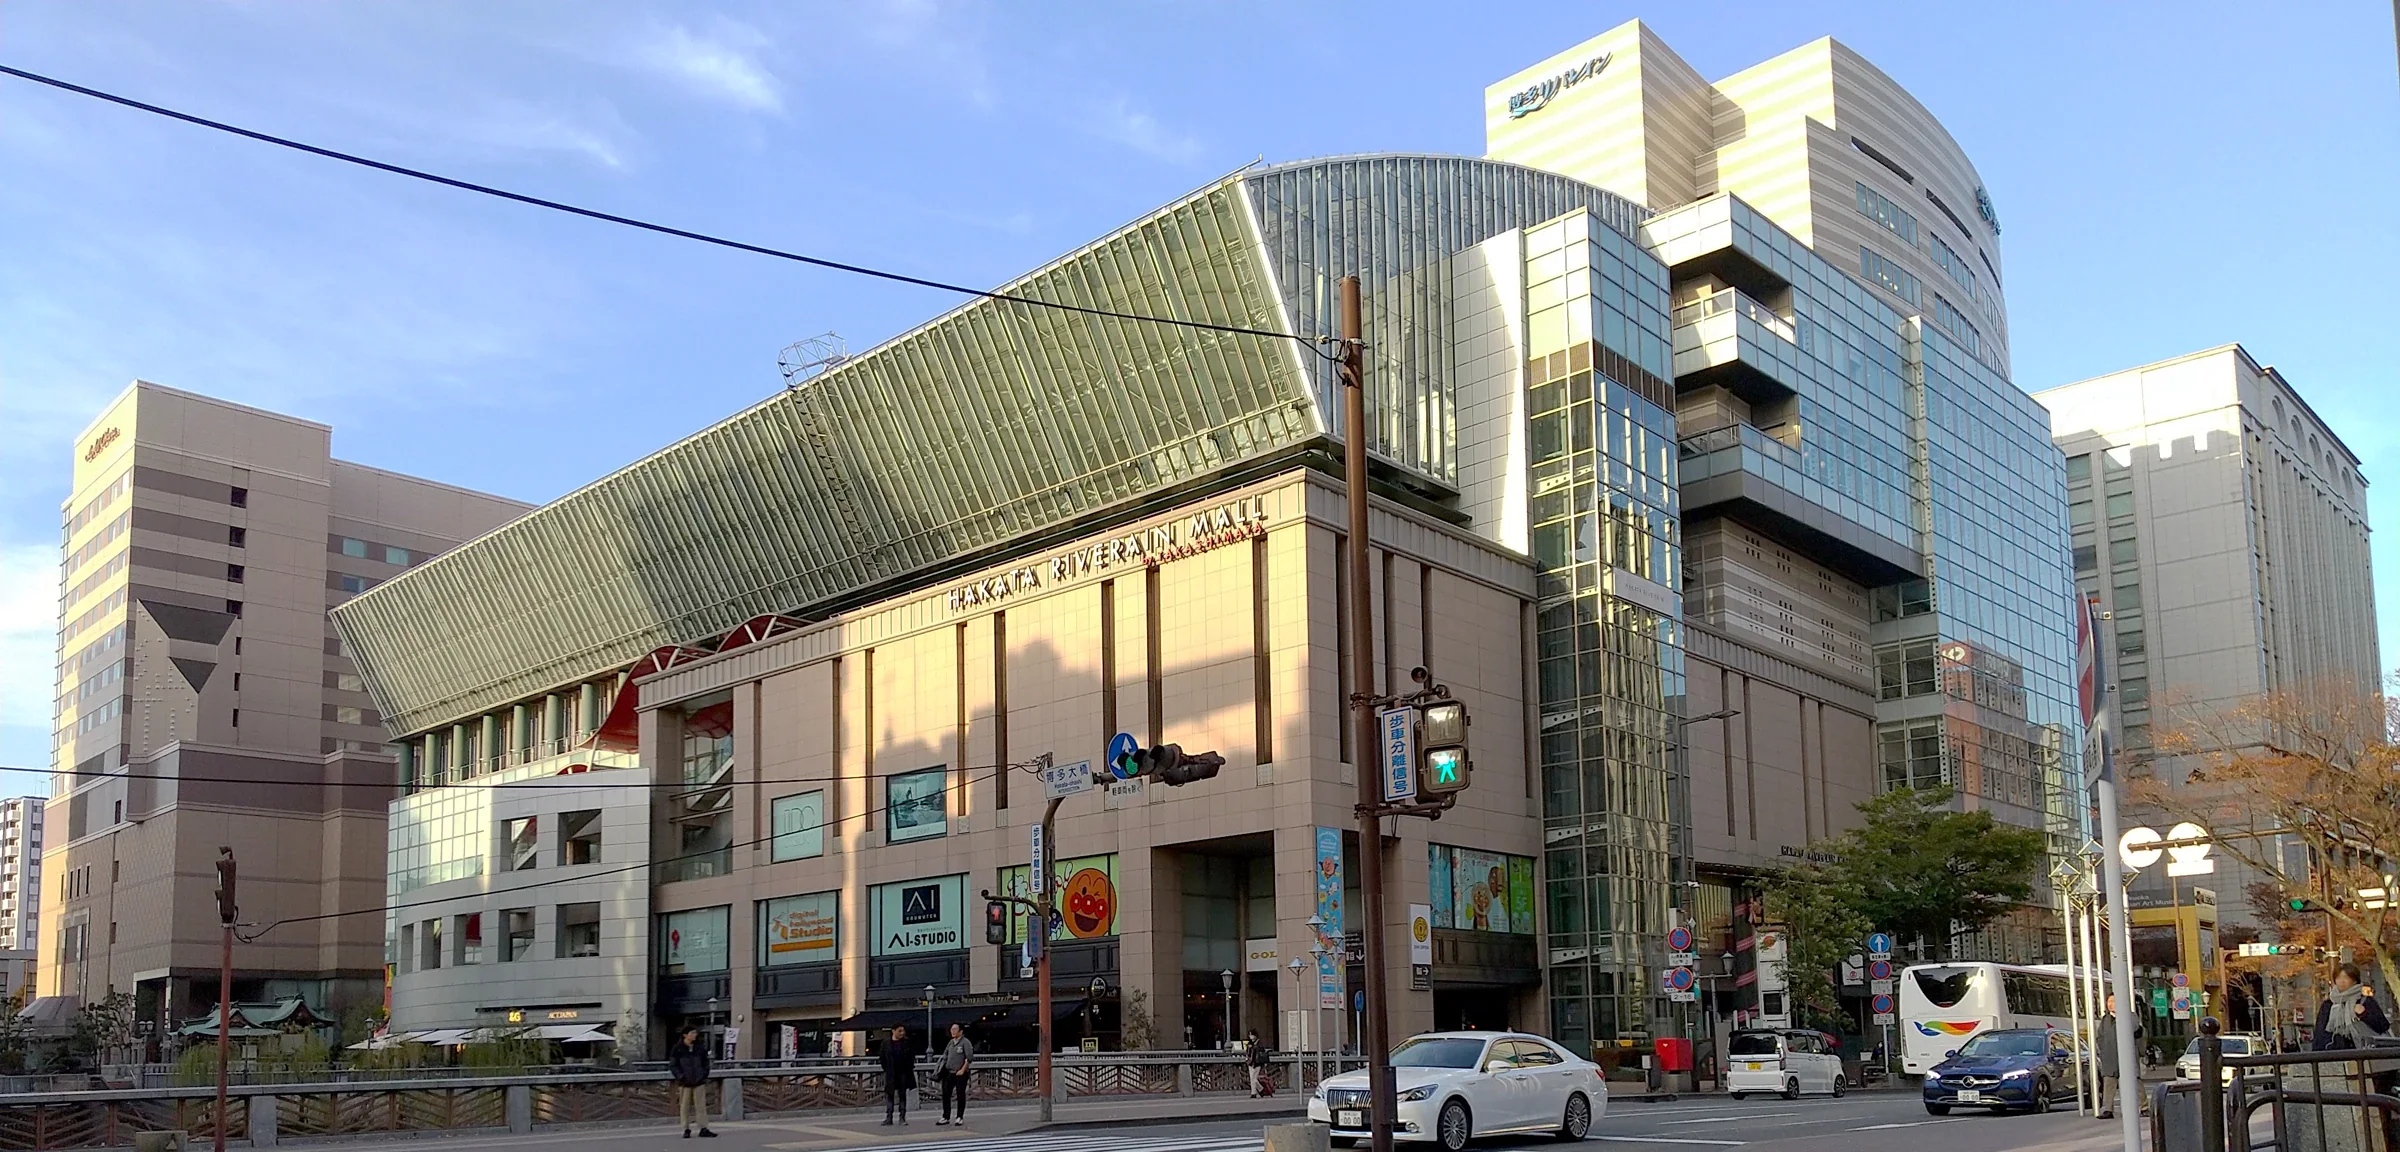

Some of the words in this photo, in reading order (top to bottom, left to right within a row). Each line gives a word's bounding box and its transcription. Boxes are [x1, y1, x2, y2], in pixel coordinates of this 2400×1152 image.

[948, 565, 1037, 610] HAKATA
[1051, 521, 1172, 579] RIVERAIN
[1189, 494, 1264, 538] MALL
[1156, 521, 1265, 562] TAKASHIMAYA
[1046, 763, 1089, 784] 博多大橋
[1389, 714, 1408, 794] 歩車分離信号
[1033, 826, 1041, 891] 歩車分離信号
[789, 926, 834, 939] Studio
[887, 930, 957, 949] AI-STUDIO
